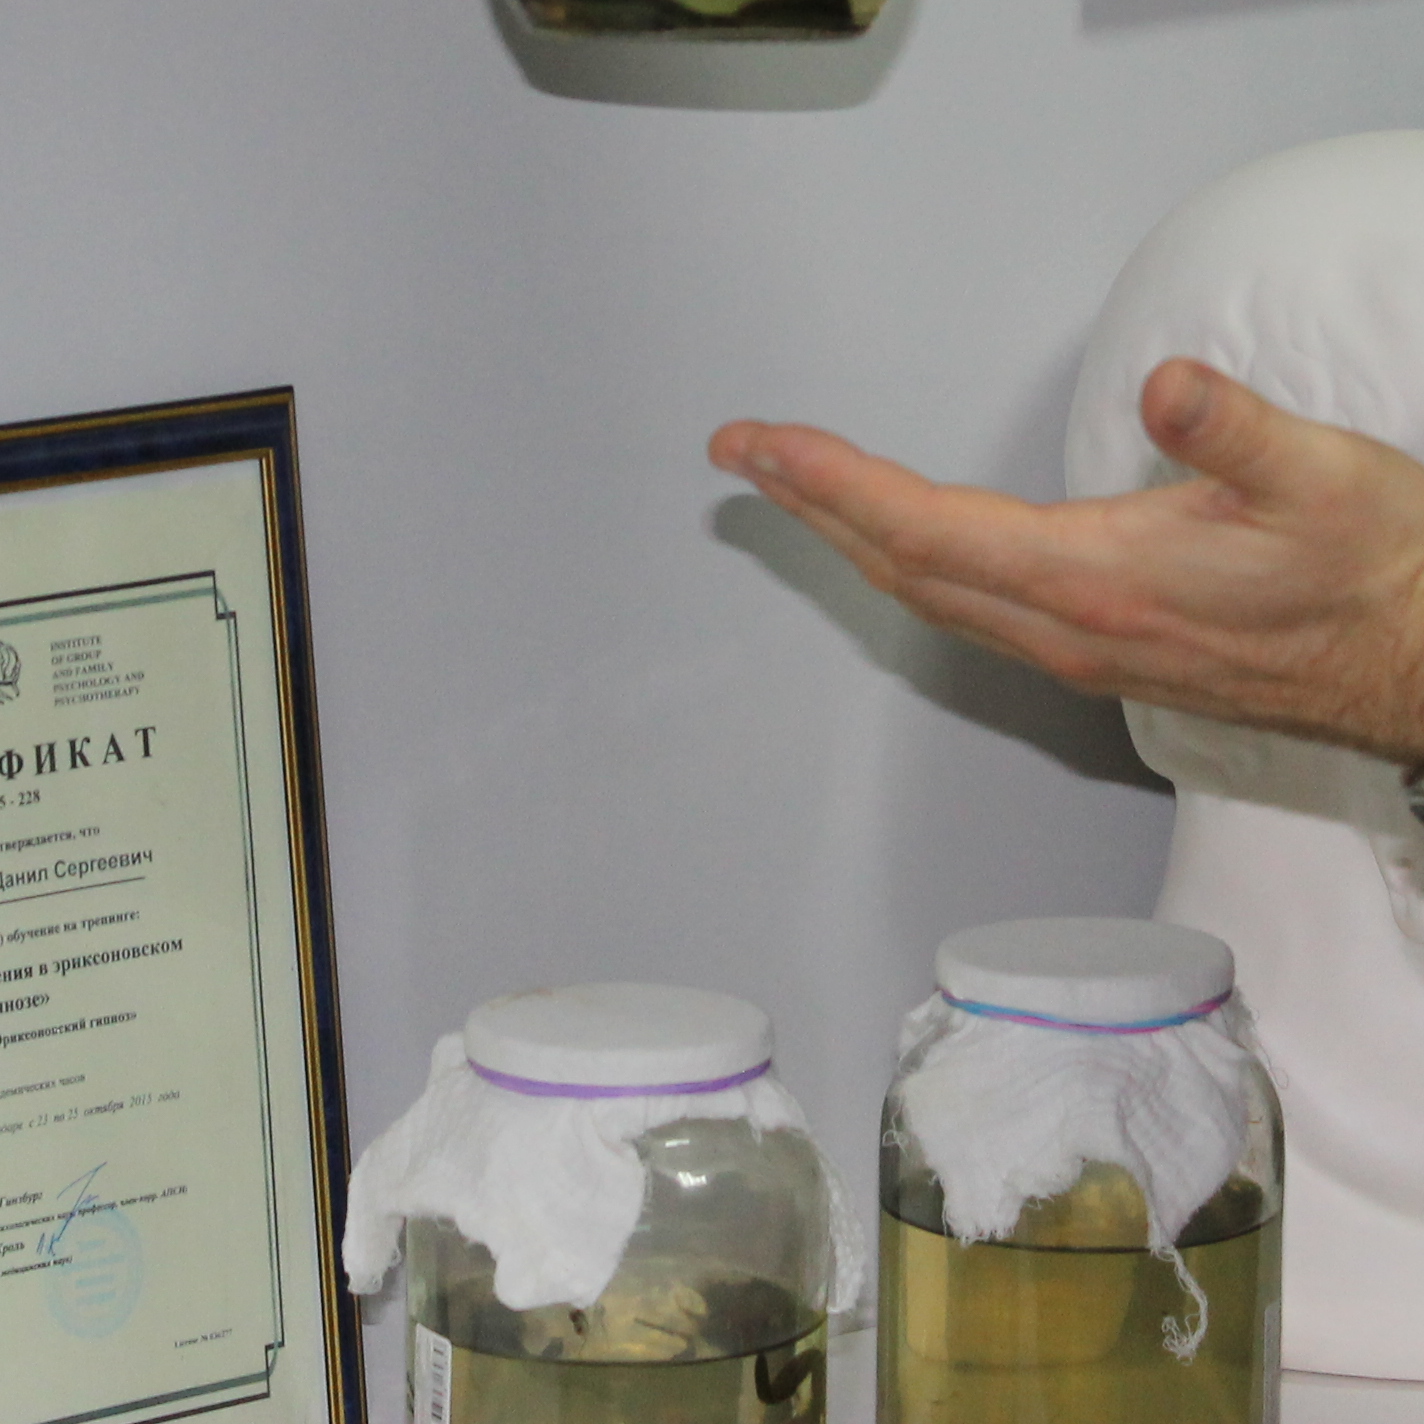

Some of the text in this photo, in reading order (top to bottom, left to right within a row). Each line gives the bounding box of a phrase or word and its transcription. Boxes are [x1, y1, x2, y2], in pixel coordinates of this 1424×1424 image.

[50, 635, 102, 651] INSTITUTE
[51, 649, 102, 665] OF GROUP
[75, 662, 114, 676] FAMILY
[53, 670, 145, 693] PSYCHOLOGY AND
[54, 685, 140, 707] PSYCHOTHERAPY
[18, 790, 41, 807] 228
[79, 826, 101, 838] что
[54, 849, 154, 880] Сергеевич
[7, 924, 61, 945] обучение
[63, 919, 78, 931] на
[39, 963, 49, 976] в
[52, 937, 184, 976] эриксоновском
[89, 1011, 138, 1029] гипноз»
[83, 1100, 125, 1118] октября
[129, 1093, 153, 1108] 2015
